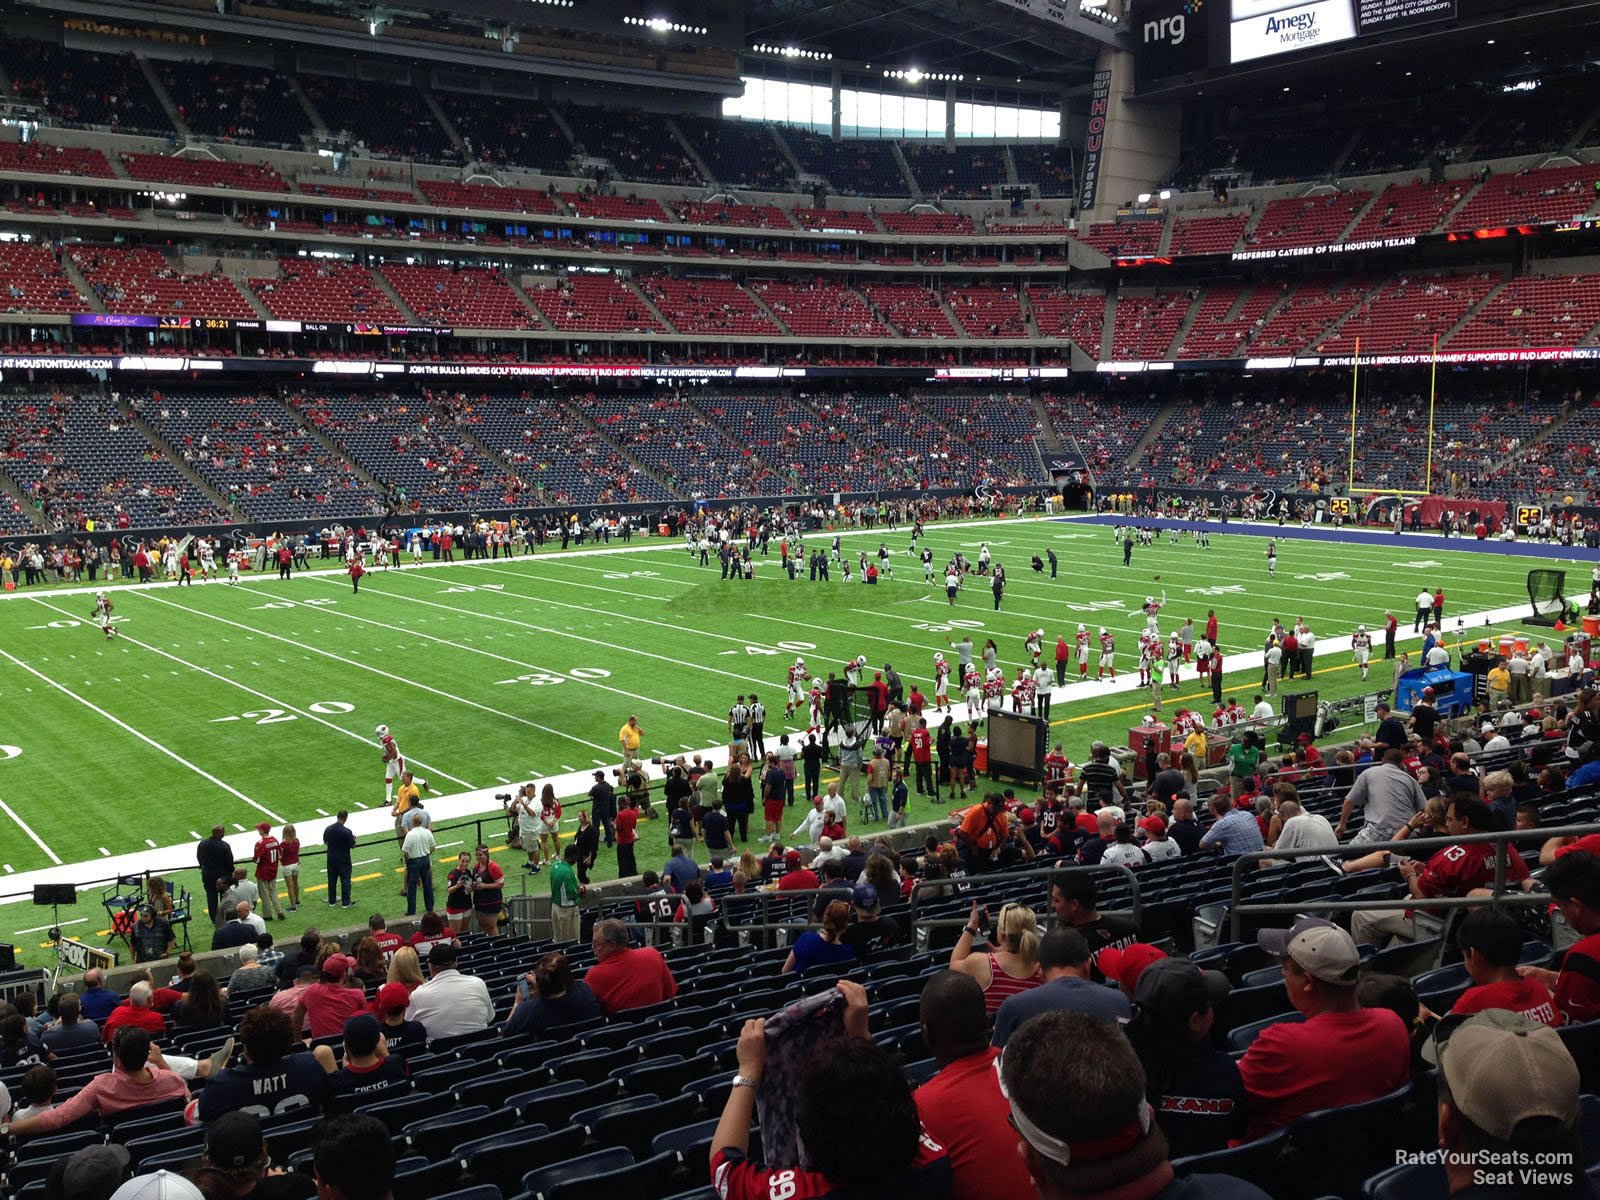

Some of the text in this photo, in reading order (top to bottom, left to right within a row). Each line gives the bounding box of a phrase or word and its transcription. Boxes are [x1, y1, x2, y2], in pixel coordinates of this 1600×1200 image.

[1361, 16, 1384, 26] (SUNDAY,
[1408, 7, 1425, 15] NOON
[1383, 5, 1404, 13] KANSAS
[1144, 15, 1185, 45] nrg
[1265, 11, 1316, 35] Amegy
[1280, 27, 1321, 44] Mortgage
[1094, 71, 1111, 80] NEED
[1093, 89, 1108, 98] TEXT
[1232, 237, 1416, 261] PREFERRED CATERER OF THE HOUSTON TEXANS
[195, 319, 201, 327] 0
[206, 319, 229, 328] 36:21
[3, 359, 14, 368] AT
[15, 359, 113, 369] HOUSTONTEXANS.COM
[1323, 358, 1338, 367] JOIN
[1338, 358, 1350, 366] THE
[1377, 356, 1400, 365] BIRDIES
[1401, 354, 1419, 364] GOLF
[1420, 353, 1466, 363] TOURNAMENT
[1467, 352, 1508, 361] SUPPORTED
[1509, 352, 1518, 361] BY
[1520, 351, 1536, 361] BUD
[1537, 351, 1558, 360] LIGHT
[1559, 351, 1571, 359] ON
[1573, 350, 1591, 359] NOV.
[1592, 350, 1598, 358] 2
[409, 366, 425, 374] JOIN
[425, 366, 438, 374] THE
[439, 366, 459, 375] BULLS
[466, 367, 490, 375] BIRDIES
[510, 367, 553, 376] TOURNAMENT
[554, 368, 590, 376] SUPPORTED
[668, 369, 731, 377] HOUSTONTEXANS.COM
[1332, 499, 1348, 514] 25
[911, 619, 985, 632] 50
[745, 641, 817, 656] 40
[517, 667, 612, 685] 30
[243, 701, 356, 725] 20
[1043, 811, 1055, 828] 99
[270, 849, 277, 863] 11
[1444, 844, 1465, 862] 13
[62, 942, 87, 969] FOX
[253, 1074, 287, 1095] WATT
